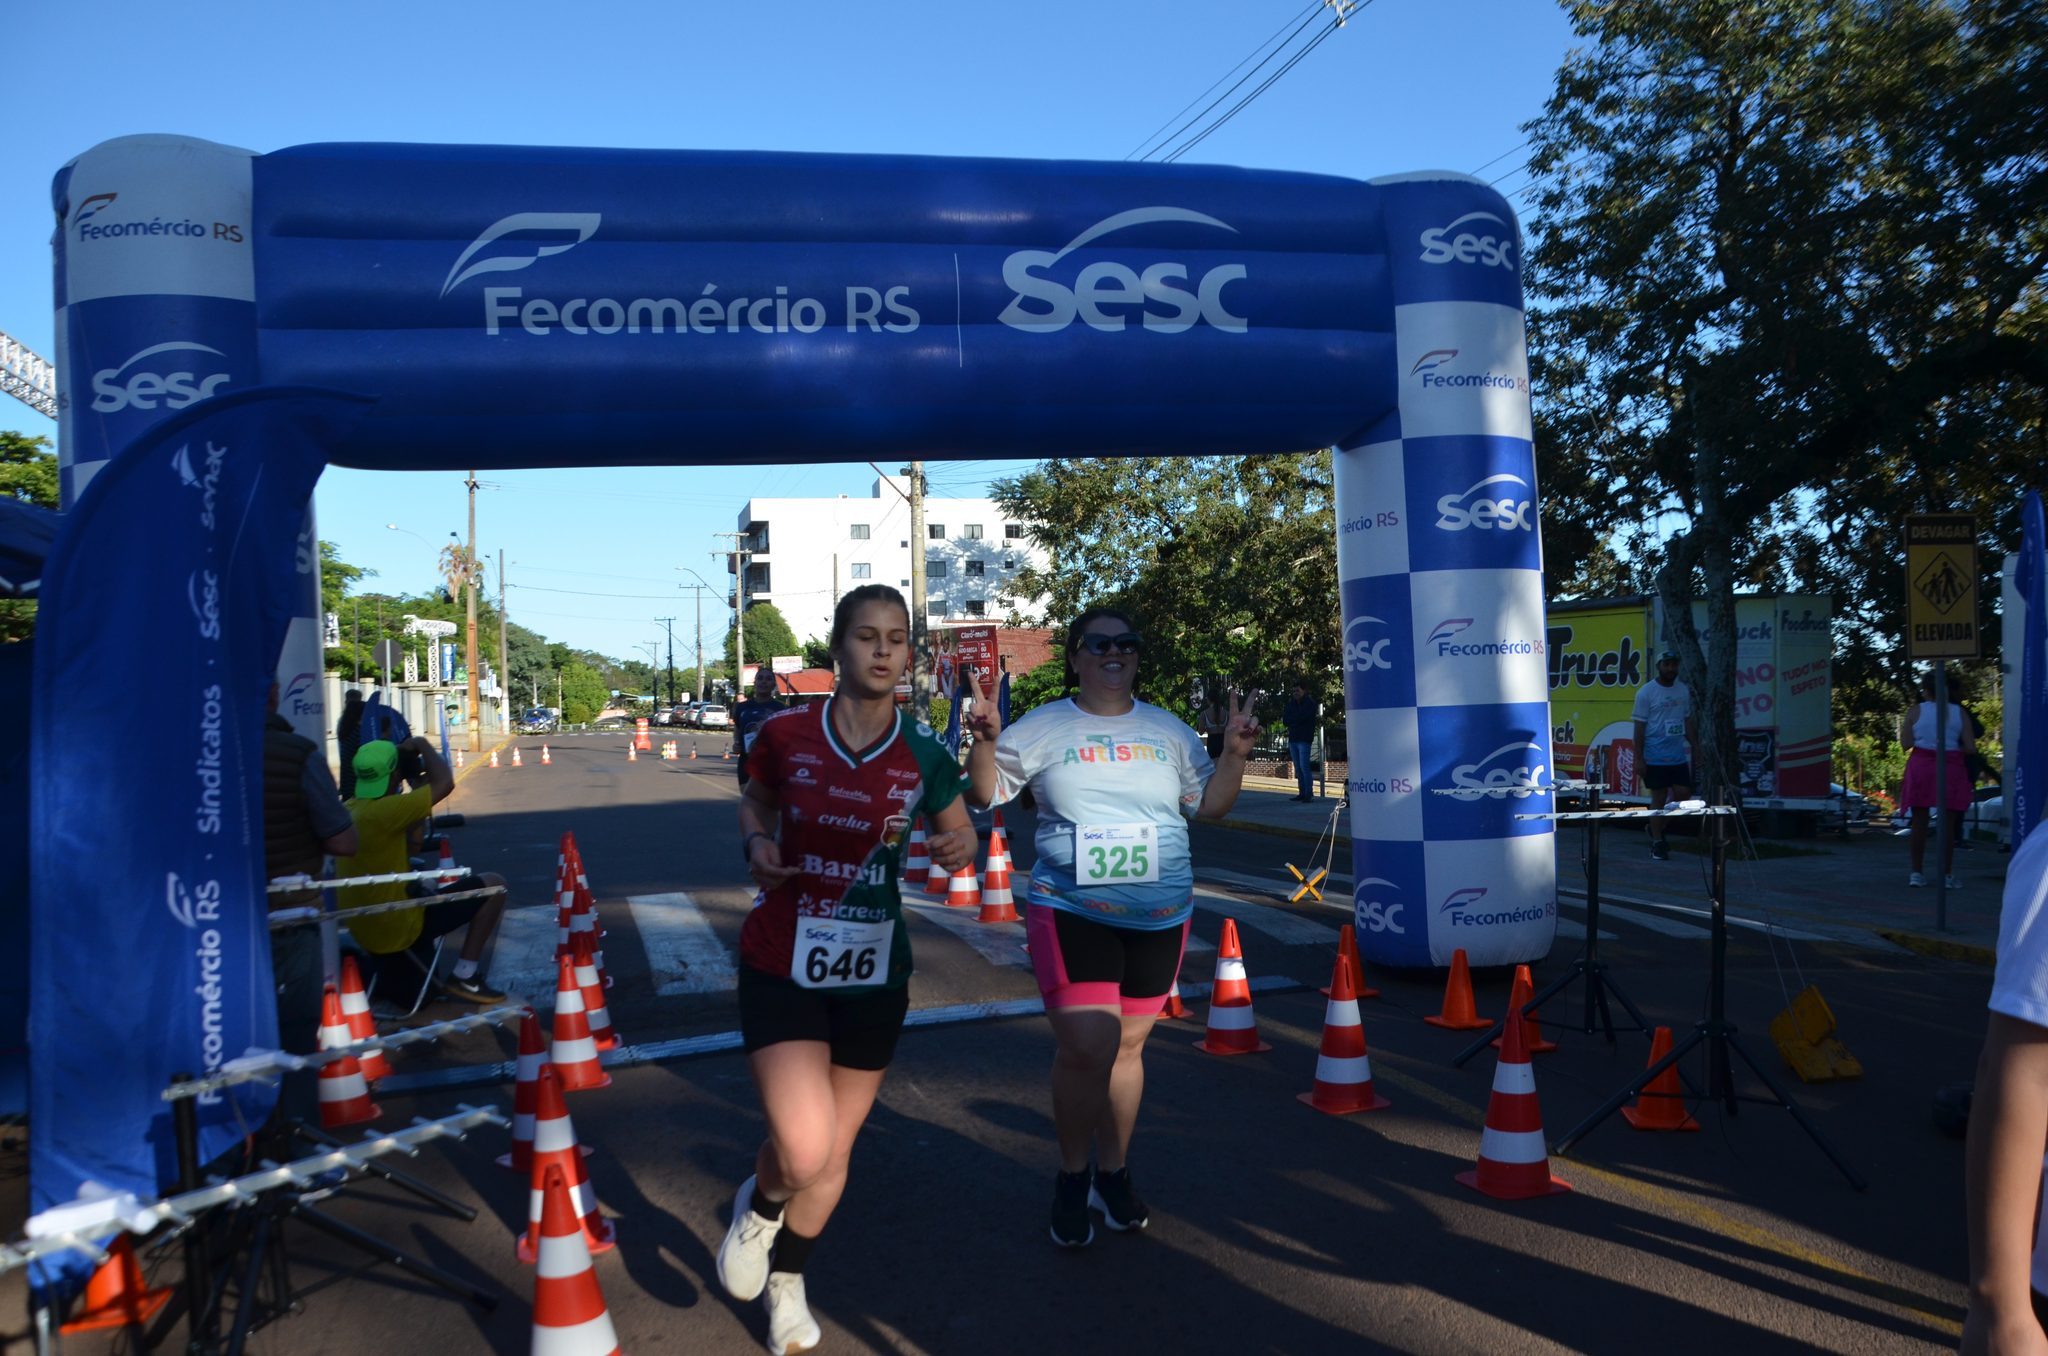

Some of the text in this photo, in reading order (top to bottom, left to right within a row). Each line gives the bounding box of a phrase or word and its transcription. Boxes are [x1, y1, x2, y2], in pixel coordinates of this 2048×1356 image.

[80, 217, 243, 243] Fecomércio RS
[1420, 228, 1514, 271] Sesc
[998, 249, 1249, 334] Sesc
[483, 285, 921, 335] Fecomércio RS
[1423, 371, 1528, 393] Fecomércio RS
[1376, 511, 1399, 528] RS
[1435, 494, 1532, 532] Sesc
[1911, 525, 1970, 539] DEVAGAR
[1915, 623, 1973, 641] ELEVADA
[1344, 638, 1392, 672] esc
[1438, 638, 1545, 657] Fecomércio RS
[1791, 675, 1826, 697] ESPETO
[196, 682, 223, 835] Sindicatos
[1064, 741, 1168, 765] Autismo
[1391, 778, 1413, 793] RS
[818, 813, 873, 833] creluz
[803, 853, 887, 886] Barril
[1088, 845, 1149, 879] 325
[195, 880, 220, 920] RS
[1356, 900, 1405, 934] esc
[1452, 907, 1543, 926] Fecomércio
[806, 945, 877, 983] 646
